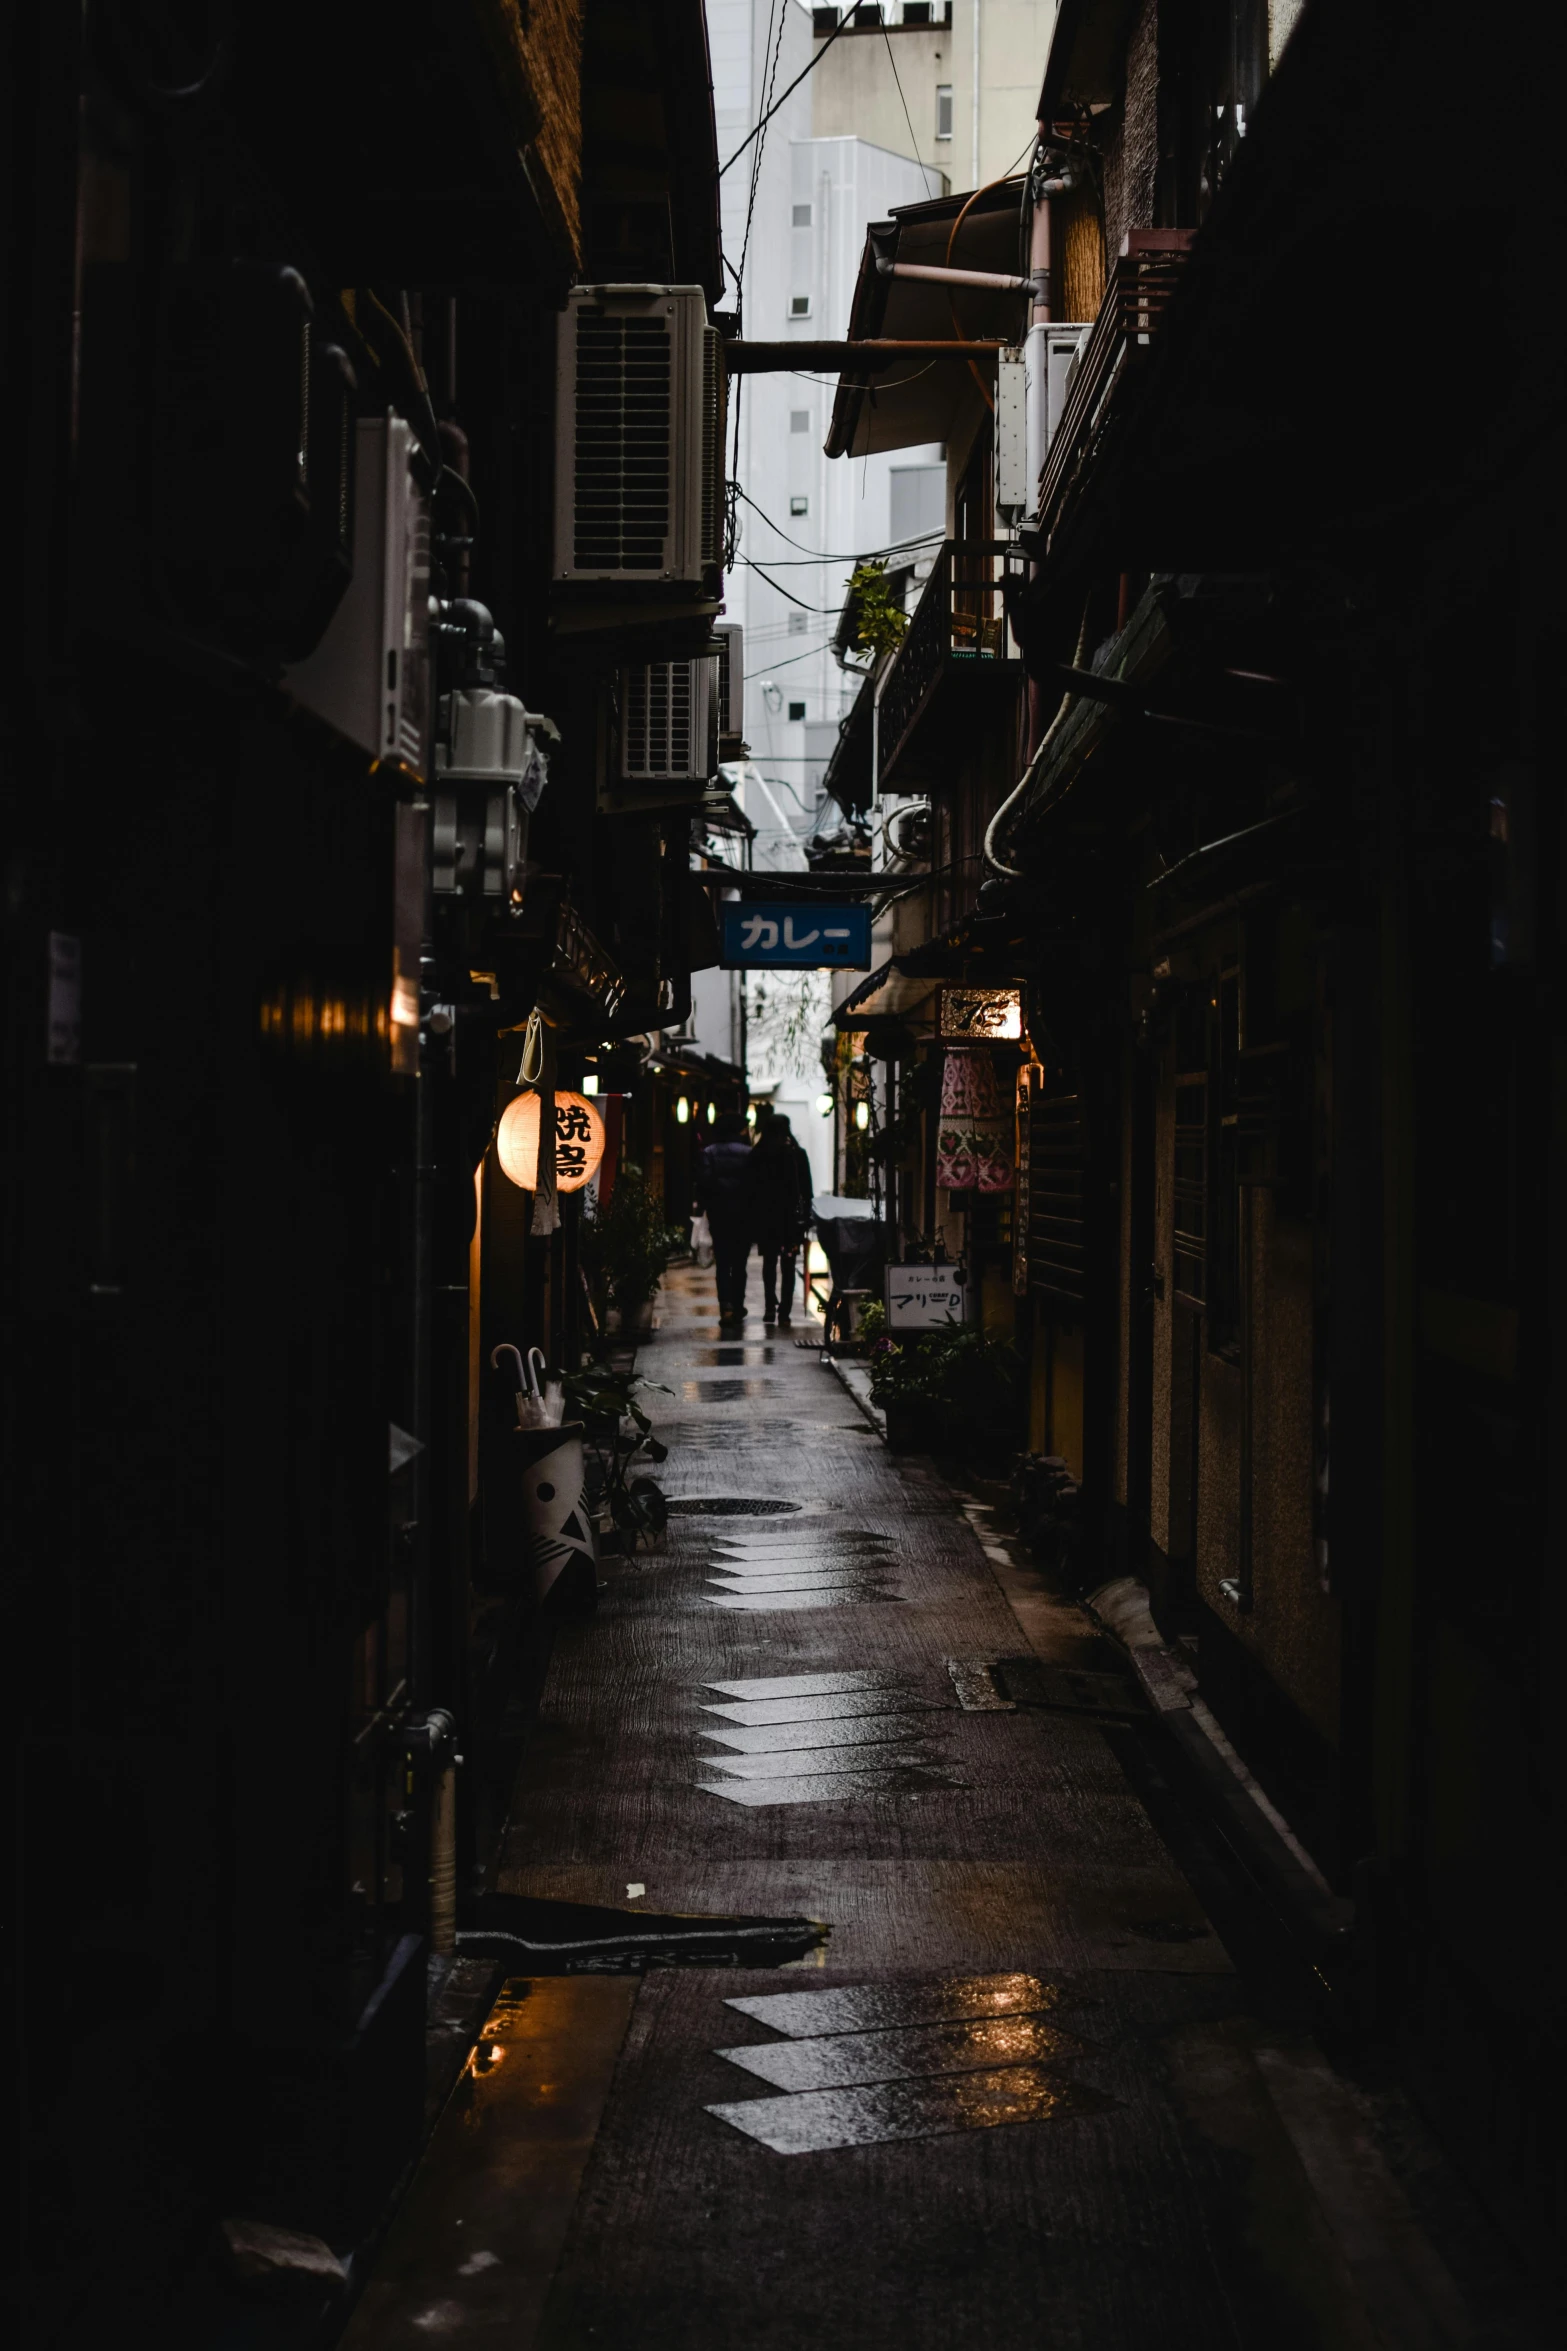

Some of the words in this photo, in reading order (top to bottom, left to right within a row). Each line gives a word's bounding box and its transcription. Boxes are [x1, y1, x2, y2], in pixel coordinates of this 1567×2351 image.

[740, 913, 851, 950] カレー
[556, 1104, 592, 1178] 焼鳥
[908, 1275, 945, 1283] カレーの店
